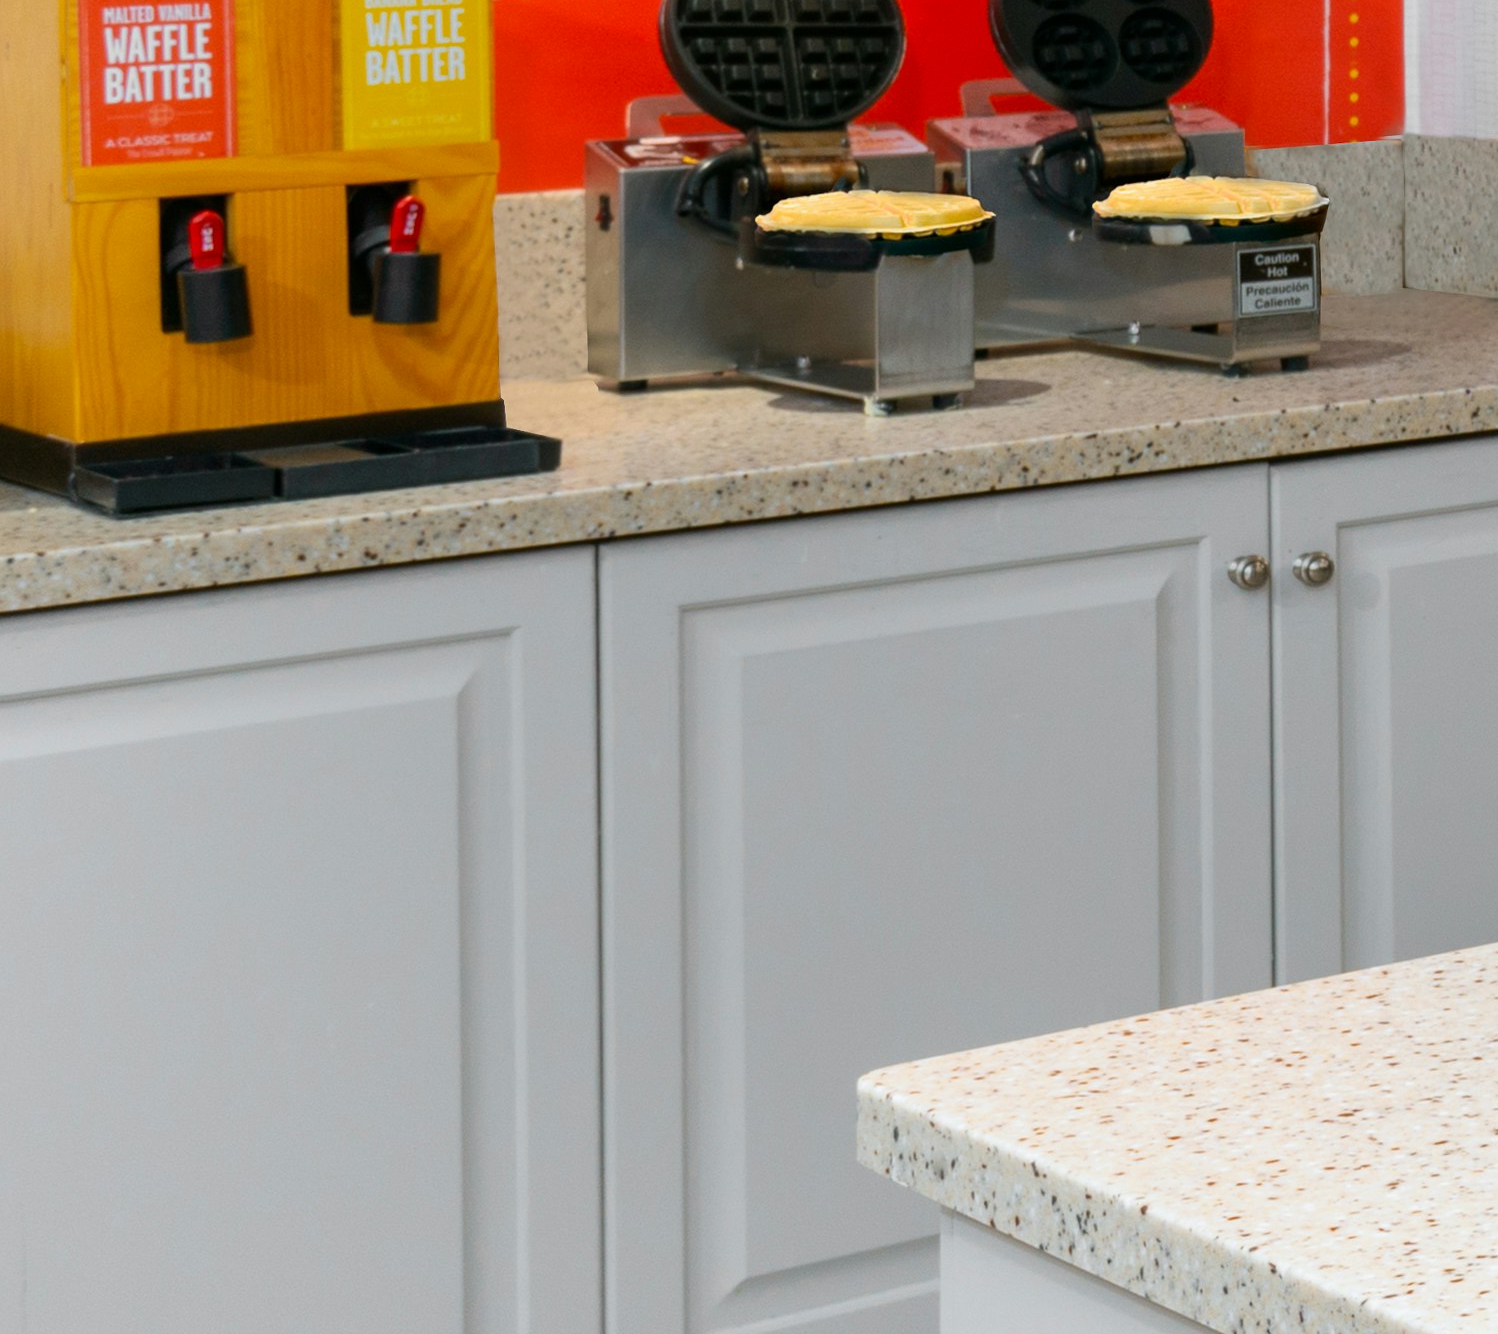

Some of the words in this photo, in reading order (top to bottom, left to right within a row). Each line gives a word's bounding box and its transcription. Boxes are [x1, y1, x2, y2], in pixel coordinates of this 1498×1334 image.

[103, 4, 155, 25] MALTED
[158, 2, 213, 22] VANILLA
[365, 7, 466, 48] WAFFLE
[104, 22, 214, 65] WAFFLE
[365, 46, 466, 87] BATTER
[104, 61, 214, 105] BATTER
[103, 137, 116, 148] A
[117, 133, 171, 149] CLASSIC
[172, 130, 215, 144] TREAT
[1254, 252, 1300, 266] Caution
[1266, 266, 1288, 278] Hot
[1245, 282, 1310, 297] Precaución
[1254, 297, 1302, 309] Caliente
